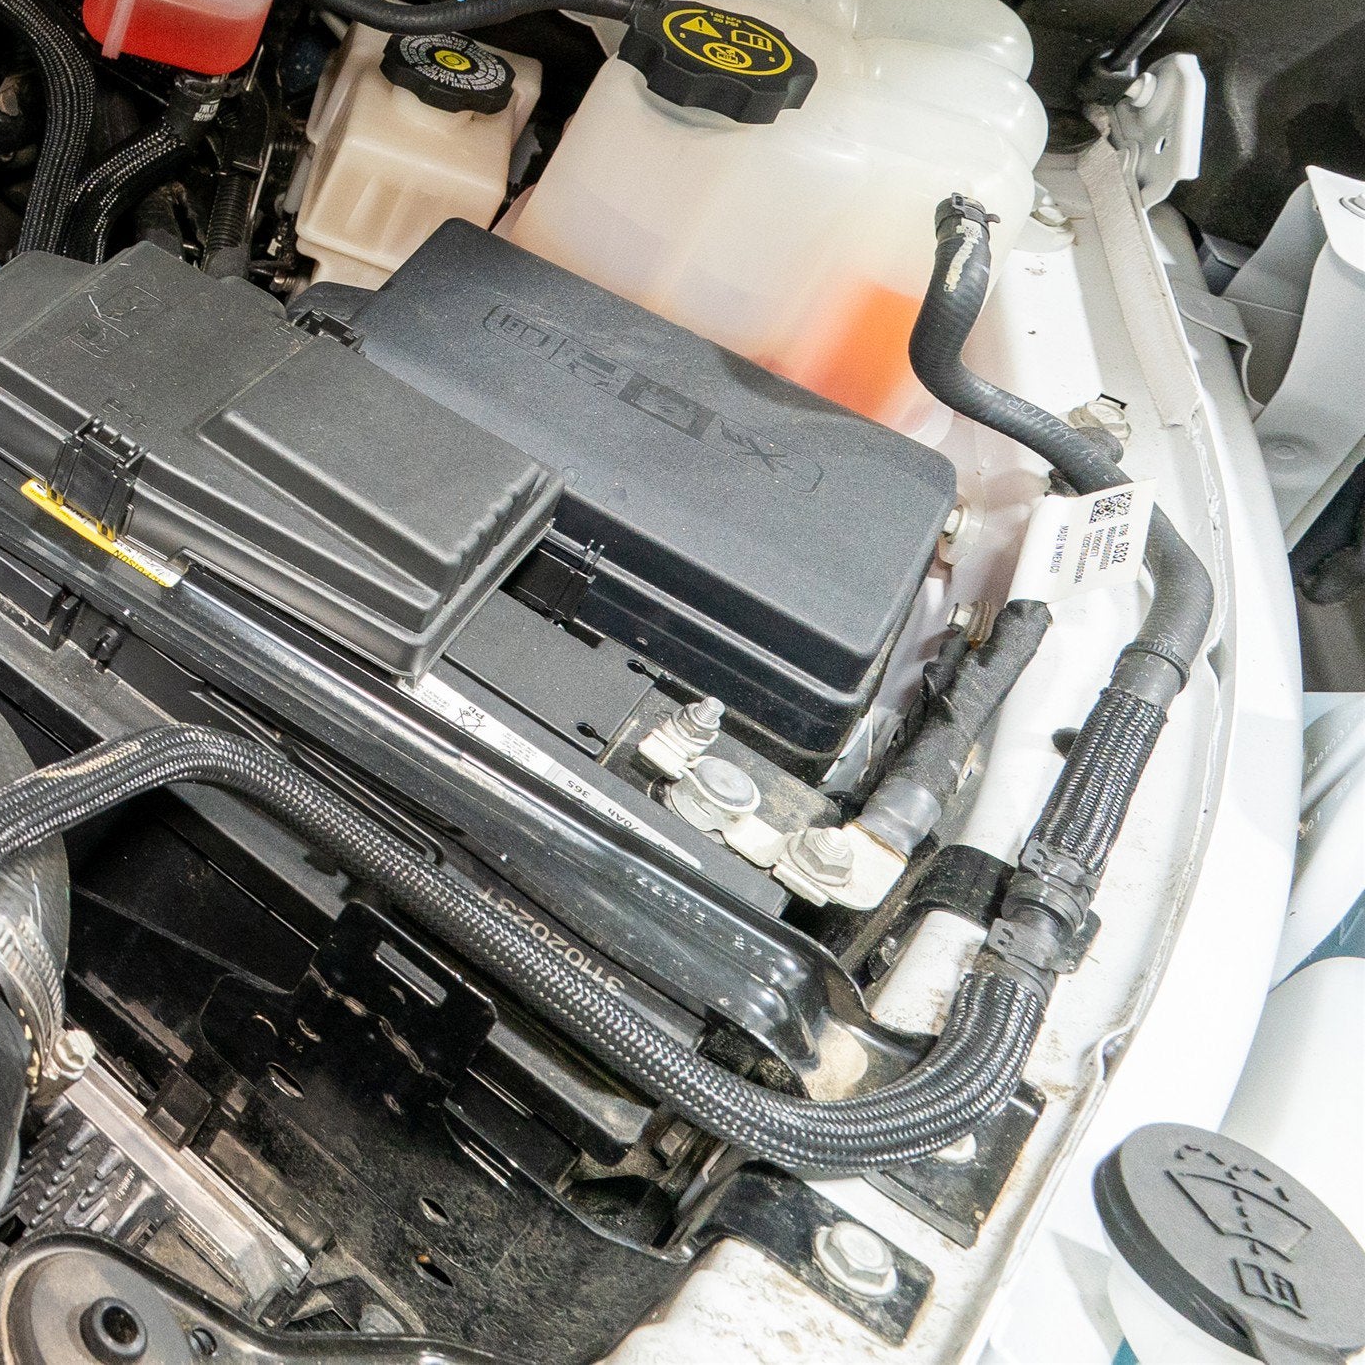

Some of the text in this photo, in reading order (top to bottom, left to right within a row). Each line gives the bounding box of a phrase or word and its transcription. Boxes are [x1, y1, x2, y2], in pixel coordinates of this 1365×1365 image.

[1049, 525, 1069, 574] MADE IN MEXICO
[1111, 541, 1130, 565] 6332
[468, 705, 485, 720] Pb
[566, 779, 640, 831] 365 70Ah
